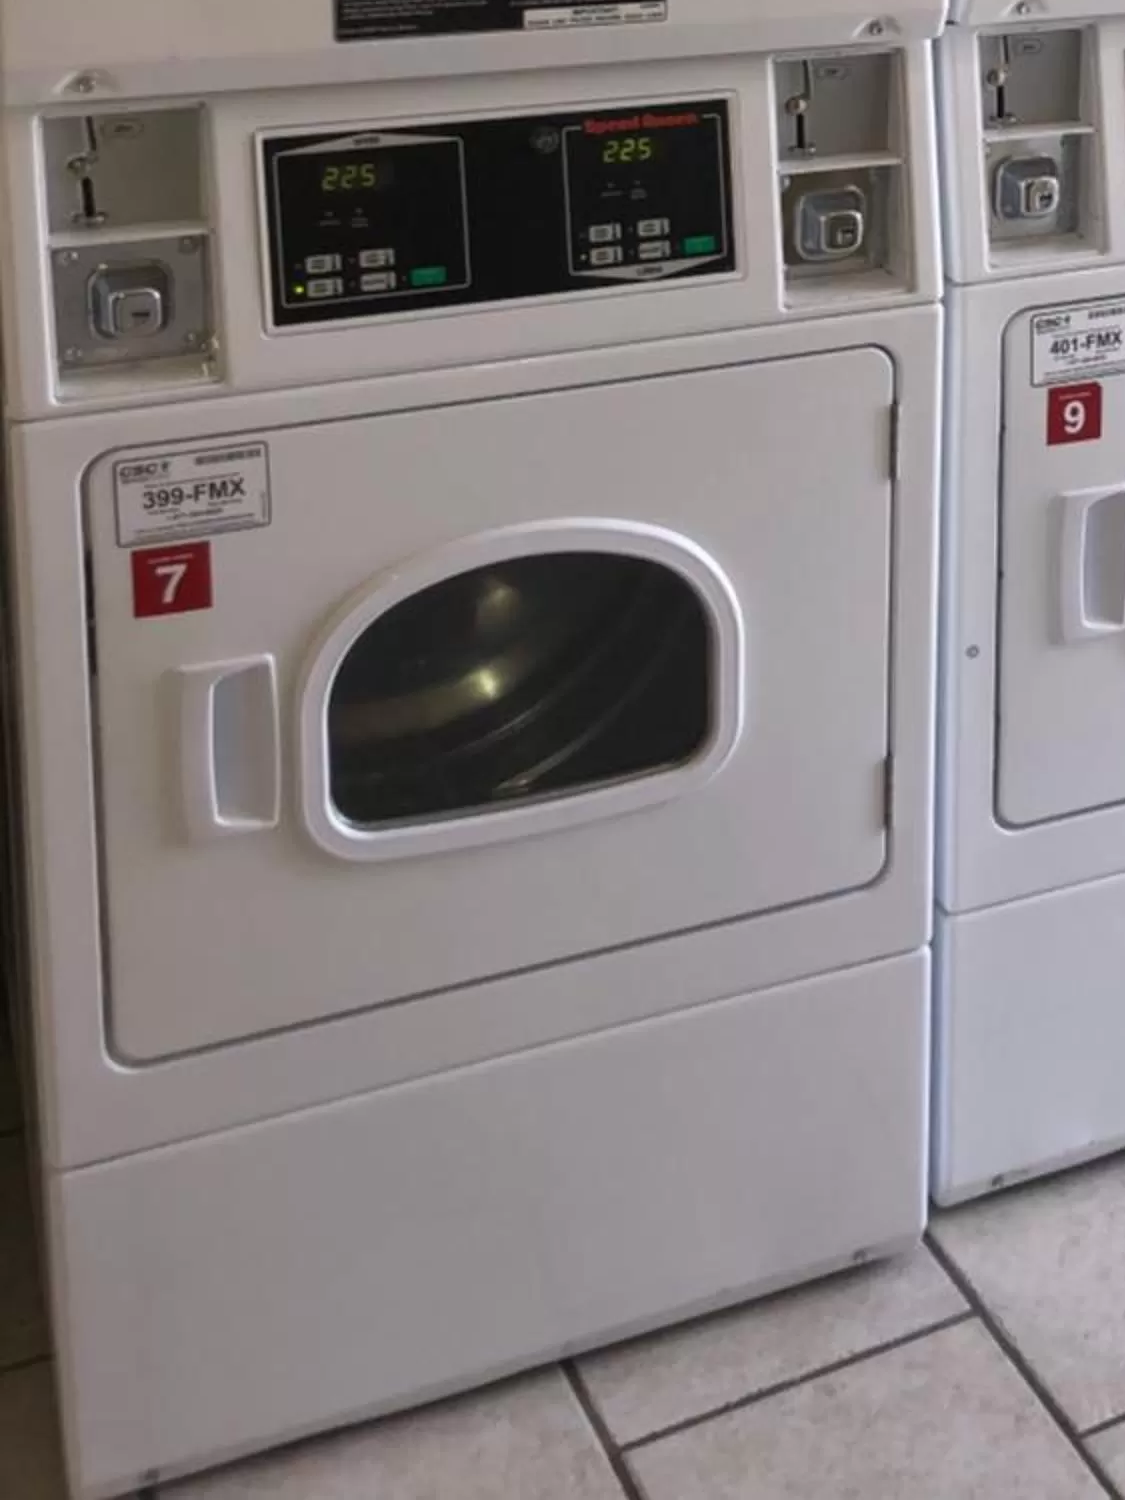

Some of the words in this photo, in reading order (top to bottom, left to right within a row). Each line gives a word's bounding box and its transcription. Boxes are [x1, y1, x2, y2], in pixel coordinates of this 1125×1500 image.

[603, 137, 652, 163] 225
[321, 163, 376, 191] 225
[1050, 331, 1123, 355] 401-FMX
[1063, 400, 1086, 434] 9
[143, 477, 246, 510] 399-FMX
[155, 563, 188, 604] 7
